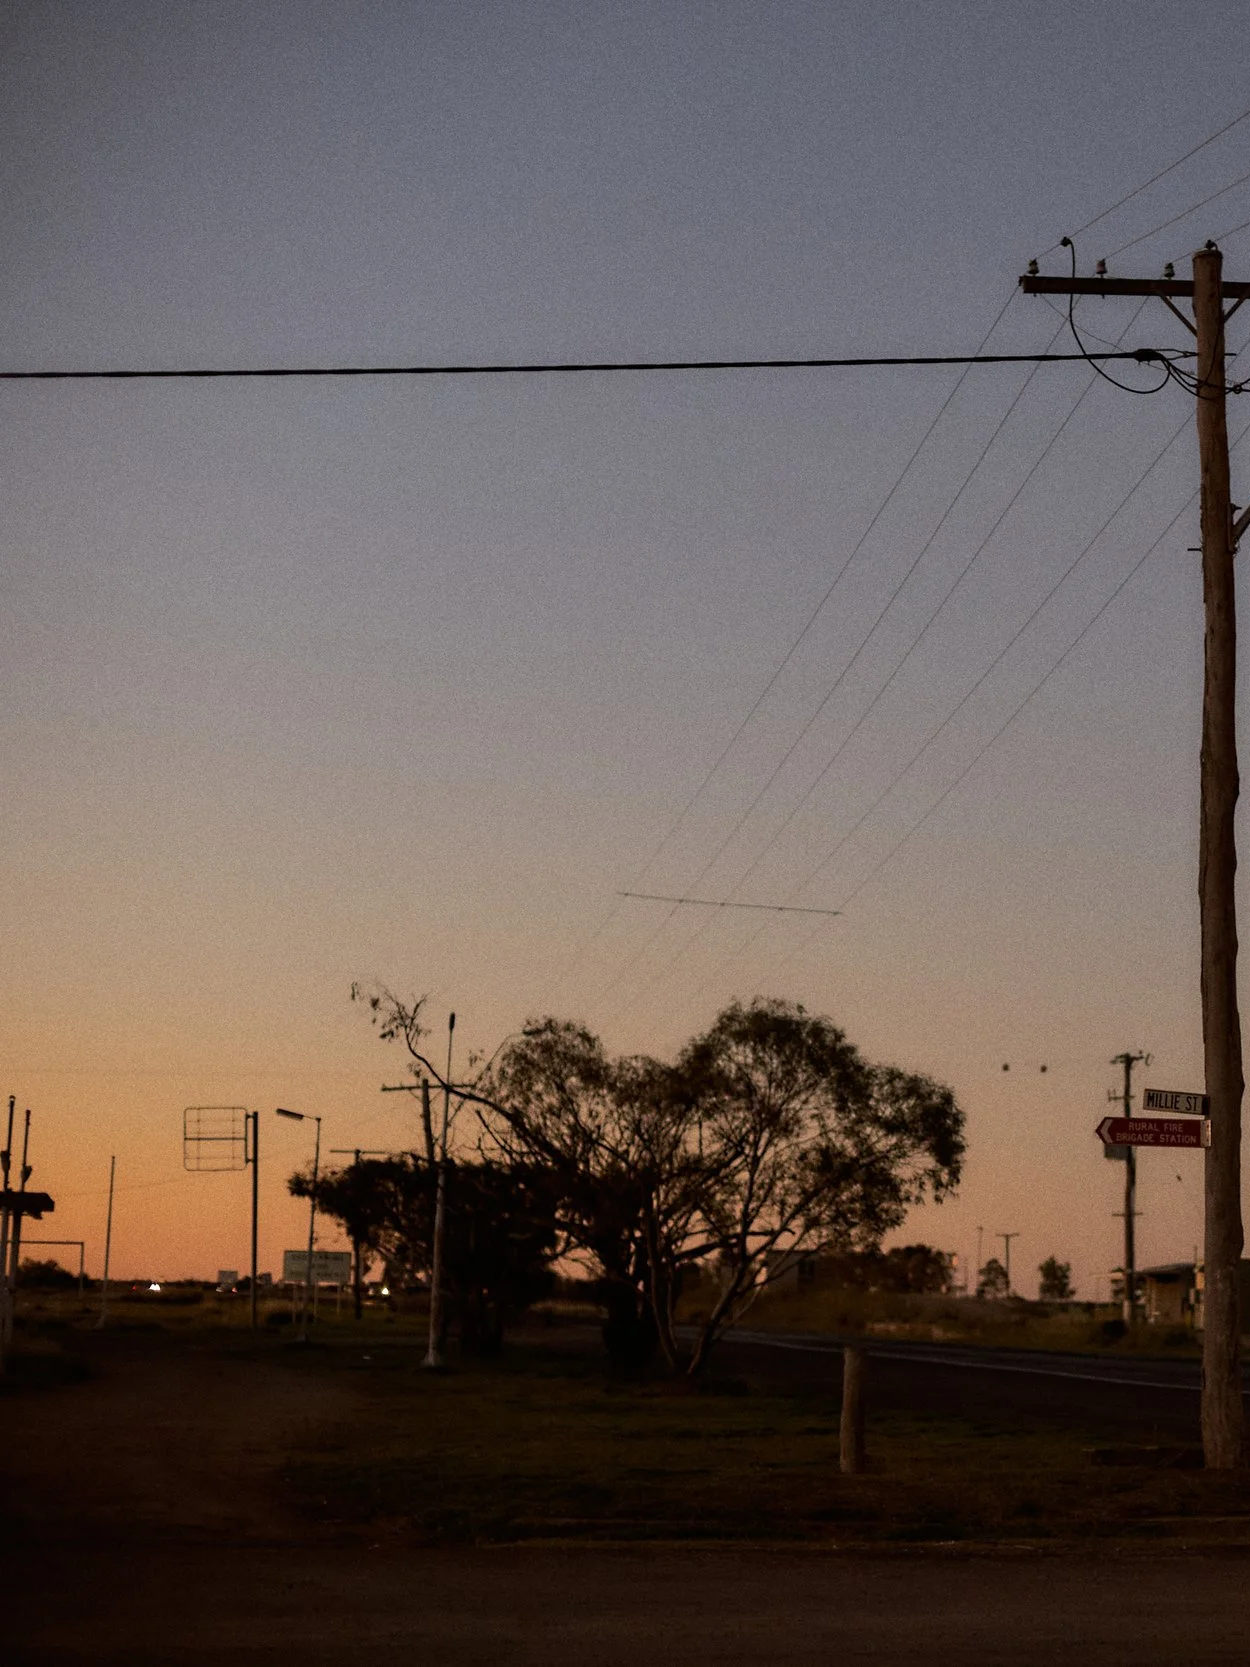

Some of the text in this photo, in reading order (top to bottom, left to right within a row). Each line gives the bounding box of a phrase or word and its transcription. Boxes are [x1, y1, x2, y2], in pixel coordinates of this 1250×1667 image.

[1146, 1092, 1198, 1112] MILLIE ST
[1128, 1121, 1185, 1133] RURAL FIRE
[1115, 1132, 1197, 1144] BRIGADE STATION
